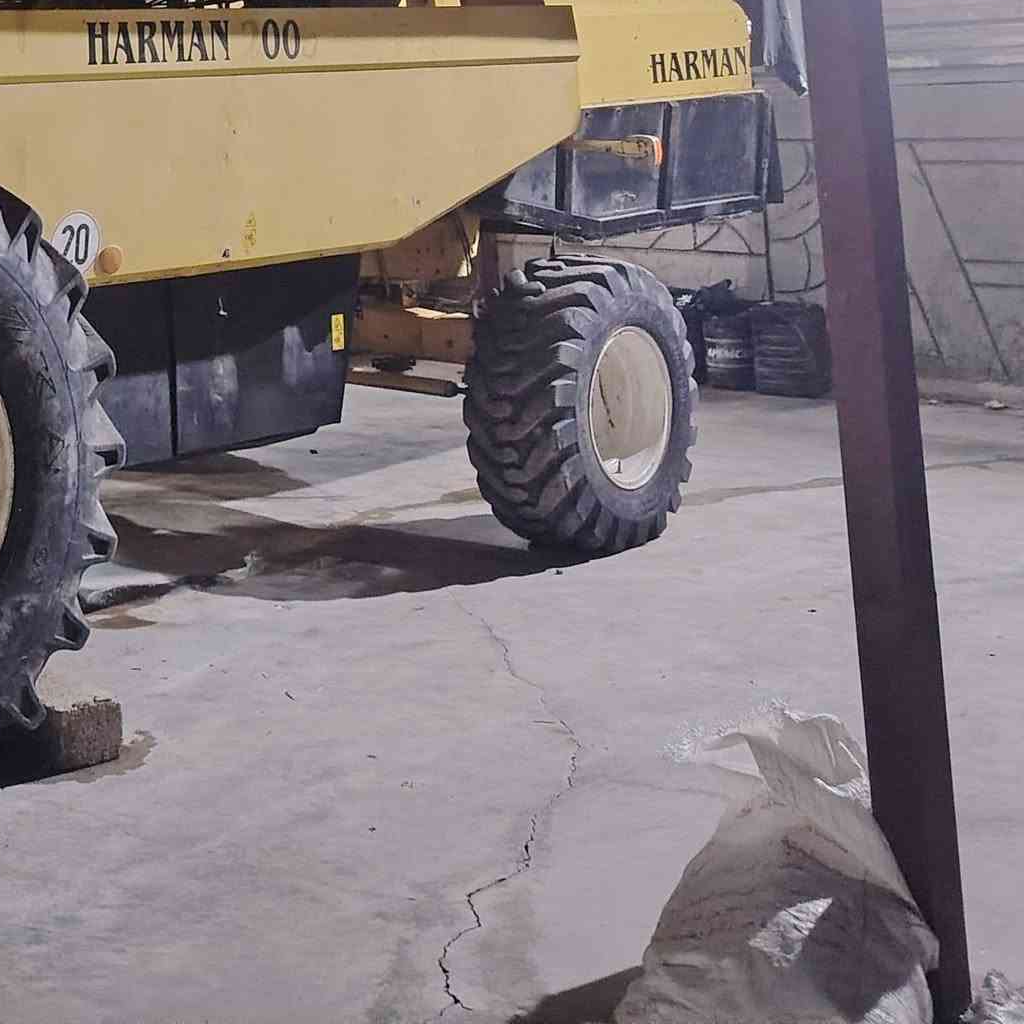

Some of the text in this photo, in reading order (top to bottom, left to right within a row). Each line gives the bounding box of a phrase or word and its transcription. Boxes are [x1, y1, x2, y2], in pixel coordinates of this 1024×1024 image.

[86, 20, 231, 65] HARMAN
[650, 46, 748, 84] HARMAN
[61, 223, 90, 265] 20
